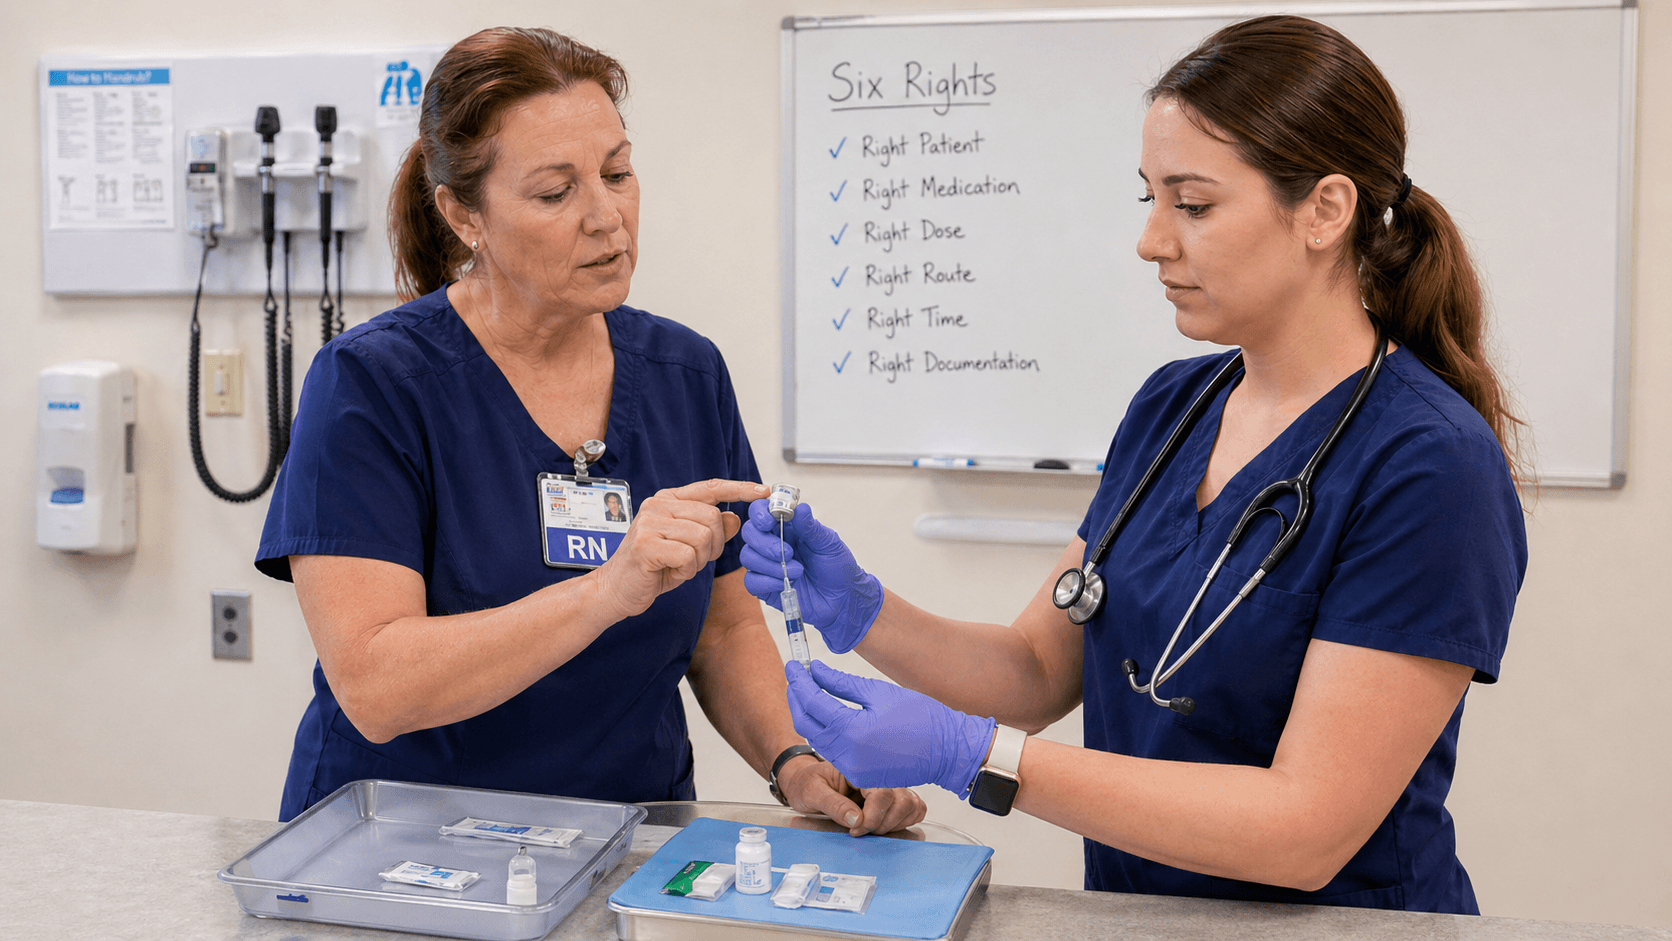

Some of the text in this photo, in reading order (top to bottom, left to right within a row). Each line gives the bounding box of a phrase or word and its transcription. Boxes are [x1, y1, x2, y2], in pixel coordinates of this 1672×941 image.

[828, 60, 997, 116] Six Rights
[862, 130, 985, 168] Right Patient
[863, 174, 1021, 210] Right Medication
[864, 219, 966, 253] Right Dose
[865, 261, 977, 296] Right Route
[867, 305, 969, 339] Right Time
[868, 350, 1040, 384] Right Documentation
[567, 534, 608, 561] RN
